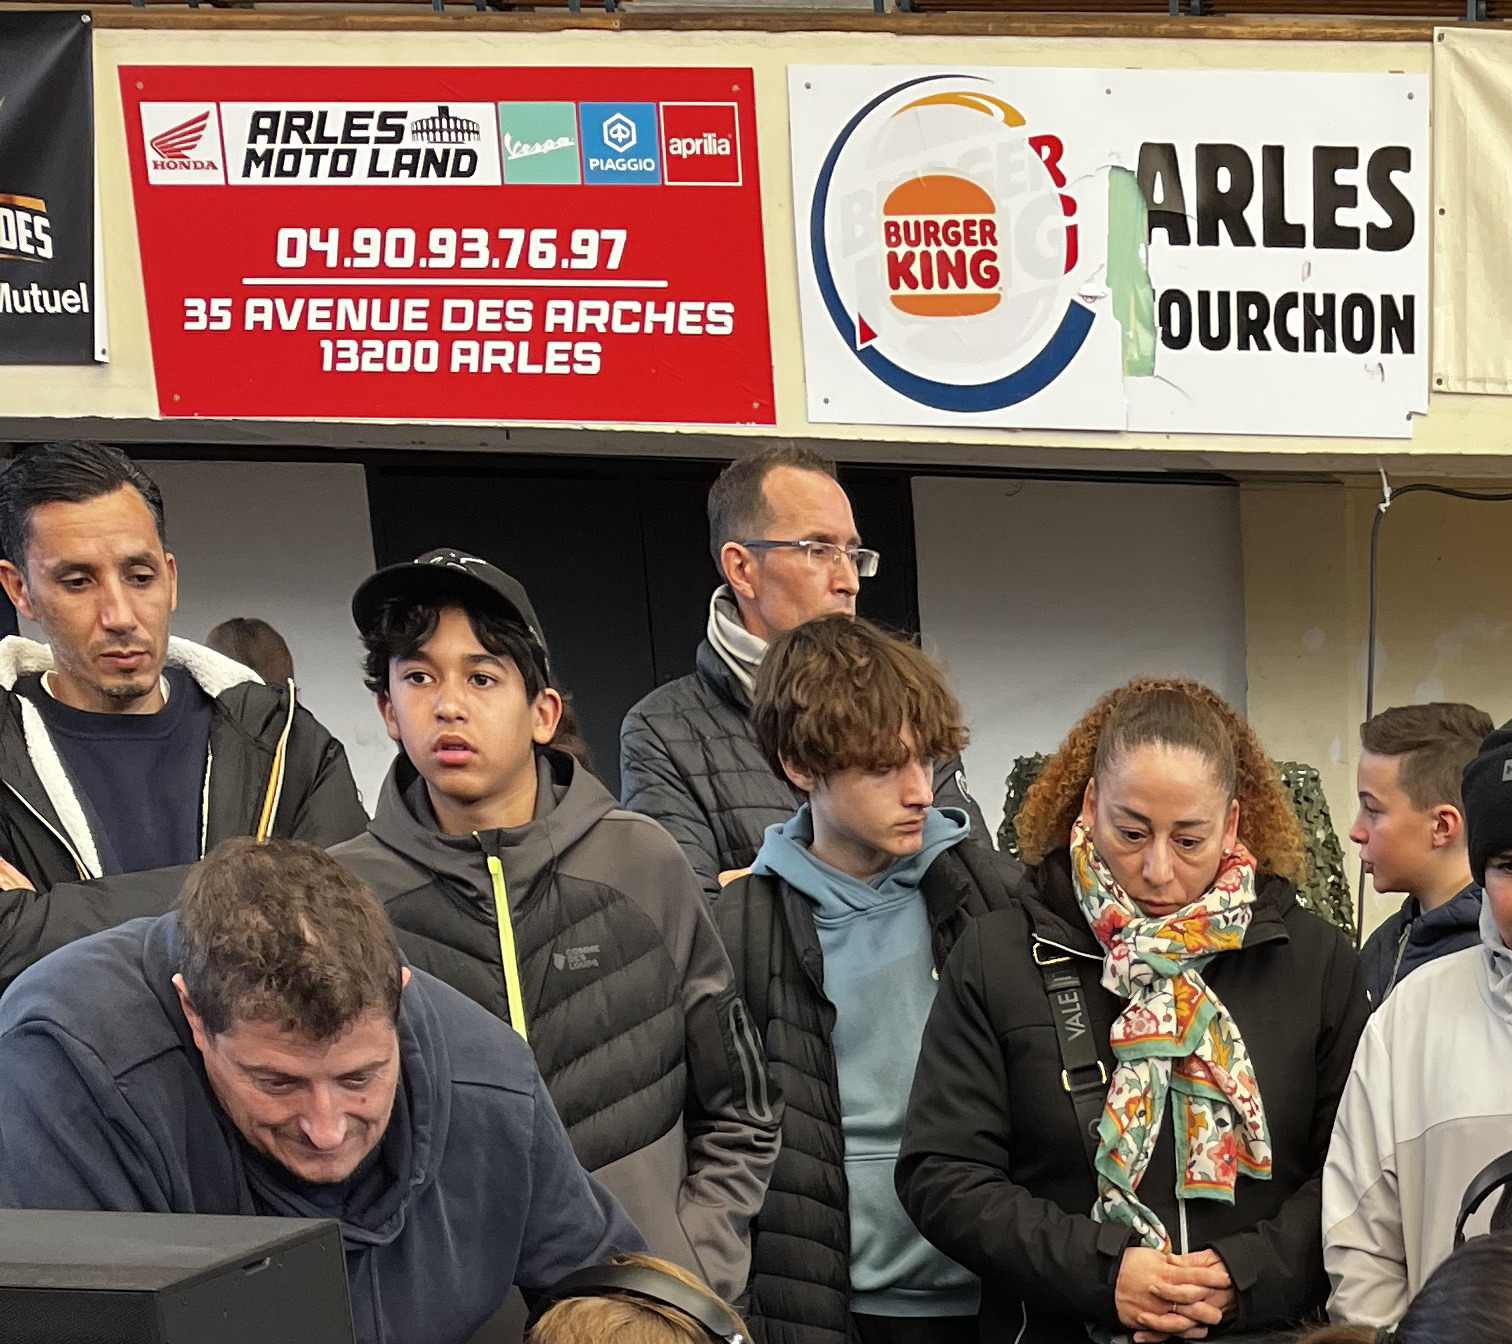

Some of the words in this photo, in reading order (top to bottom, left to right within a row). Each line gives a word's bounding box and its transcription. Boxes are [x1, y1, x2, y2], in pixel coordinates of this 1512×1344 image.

[247, 110, 408, 145] ARLES
[503, 132, 575, 160] Vespa
[669, 132, 730, 159] aprilia
[152, 160, 218, 171] HONDA
[242, 148, 356, 179] MOTO
[367, 148, 478, 178] LAND
[589, 158, 655, 172] PIAGGIO
[1137, 142, 1416, 252] ARLES
[277, 227, 627, 269] 04.90.93.76.97
[884, 219, 998, 247] BURGER
[887, 249, 1000, 290] KING
[184, 298, 232, 331] 35
[244, 298, 430, 331] AVENUE
[441, 299, 534, 333] DES
[545, 300, 735, 335] ARCHES
[1150, 288, 1415, 355] OURCHON
[320, 339, 439, 373] 13200
[450, 340, 602, 375] ARLES
[1057, 990, 1086, 1042] VALE
